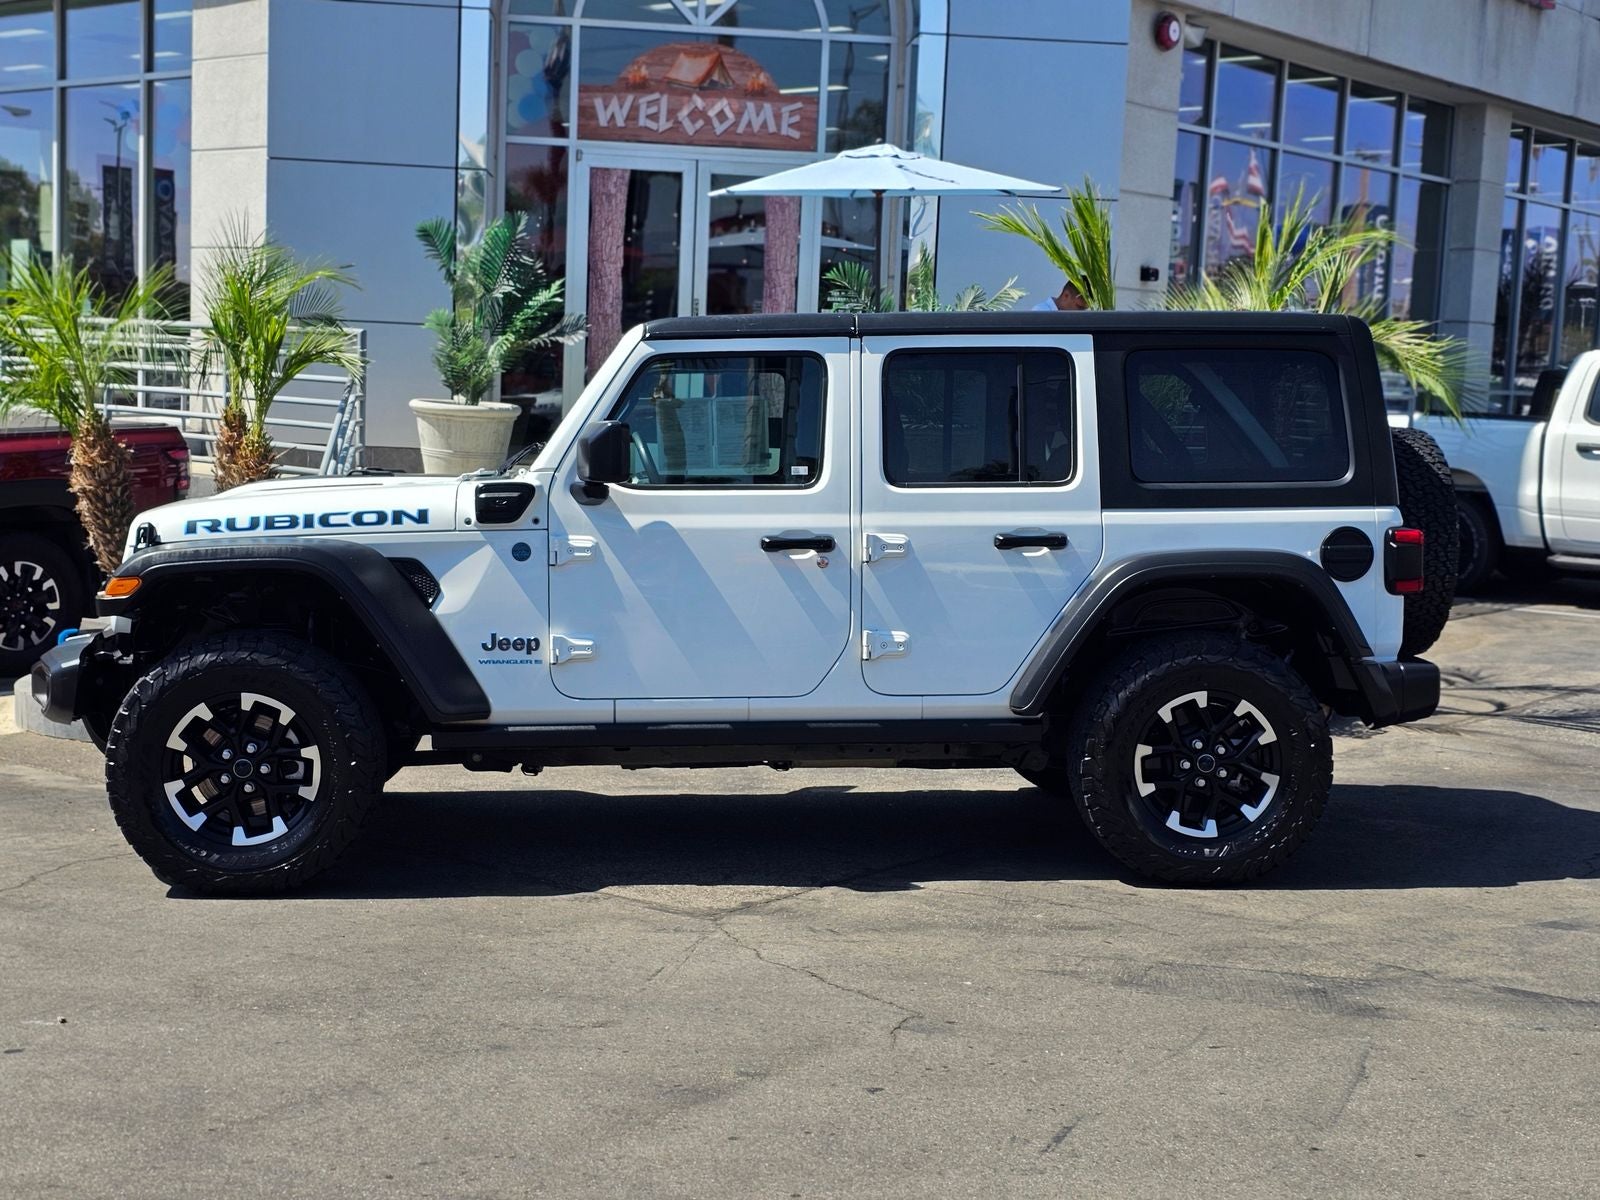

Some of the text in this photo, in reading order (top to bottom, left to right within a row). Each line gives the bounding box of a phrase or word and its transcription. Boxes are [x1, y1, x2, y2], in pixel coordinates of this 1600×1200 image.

[593, 92, 804, 140] WELCOME
[184, 508, 430, 536] RUBICON
[481, 632, 541, 655] Jeep
